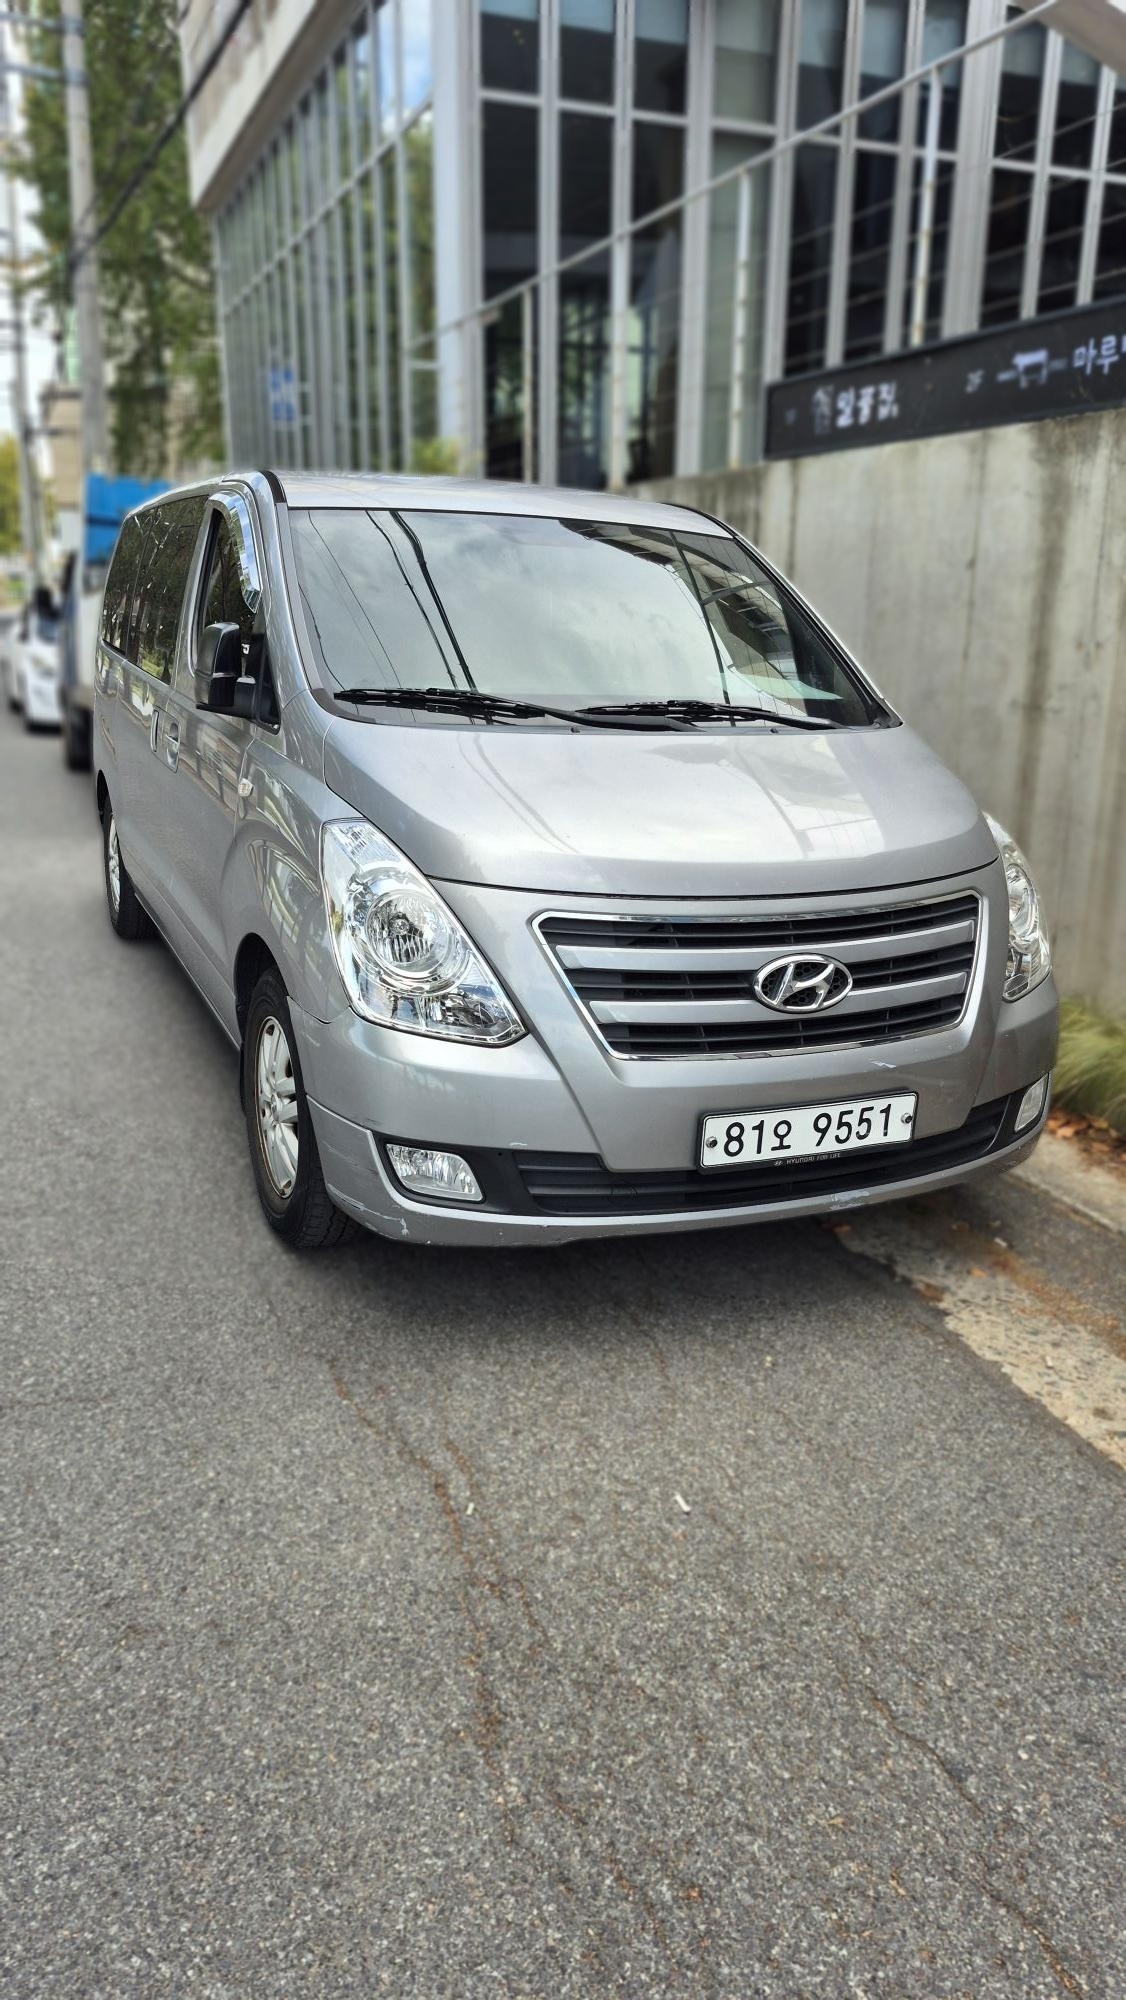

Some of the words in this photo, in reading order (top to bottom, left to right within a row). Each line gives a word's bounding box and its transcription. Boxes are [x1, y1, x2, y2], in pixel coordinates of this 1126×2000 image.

[1073, 334, 1126, 375] 마루
[723, 1119, 792, 1157] 81오
[813, 1103, 893, 1147] 9551
[786, 1156, 815, 1165] HYUNDAI
